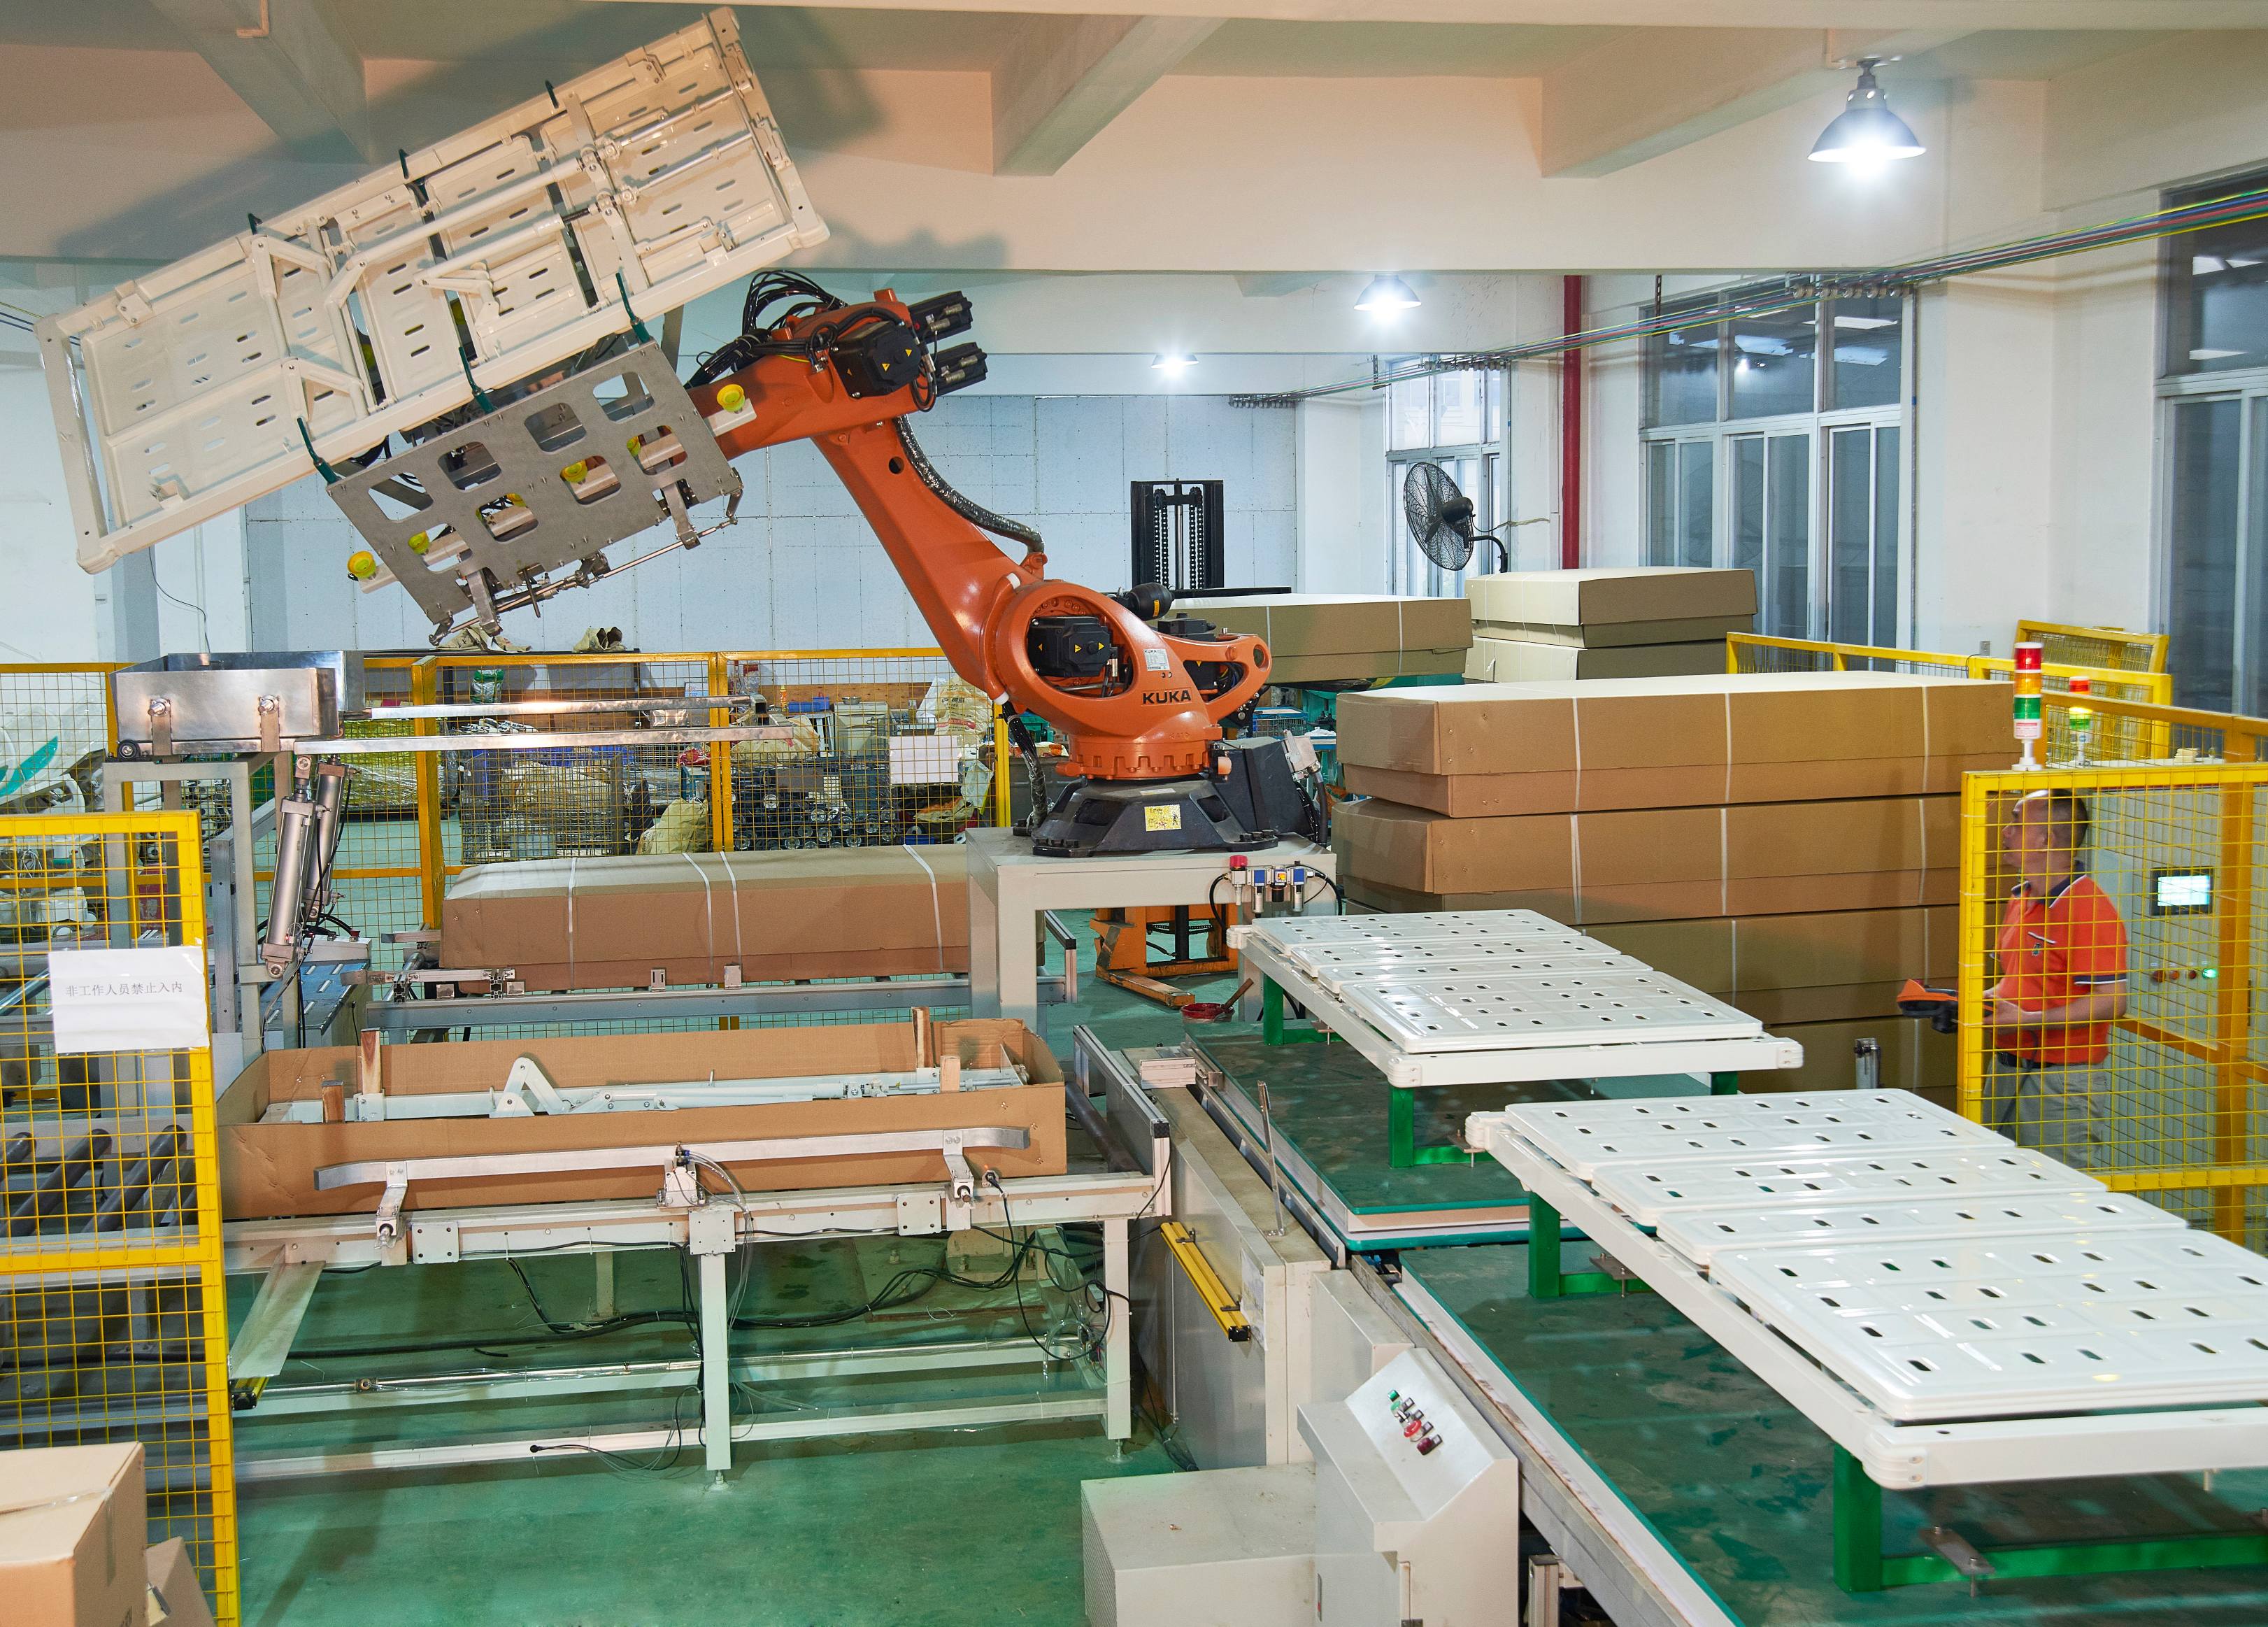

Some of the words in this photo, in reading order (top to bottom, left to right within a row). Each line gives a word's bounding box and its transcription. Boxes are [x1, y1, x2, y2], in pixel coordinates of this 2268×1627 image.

[1143, 690, 1192, 704] KUKA
[66, 981, 183, 997] 非工作人员禁止入内
